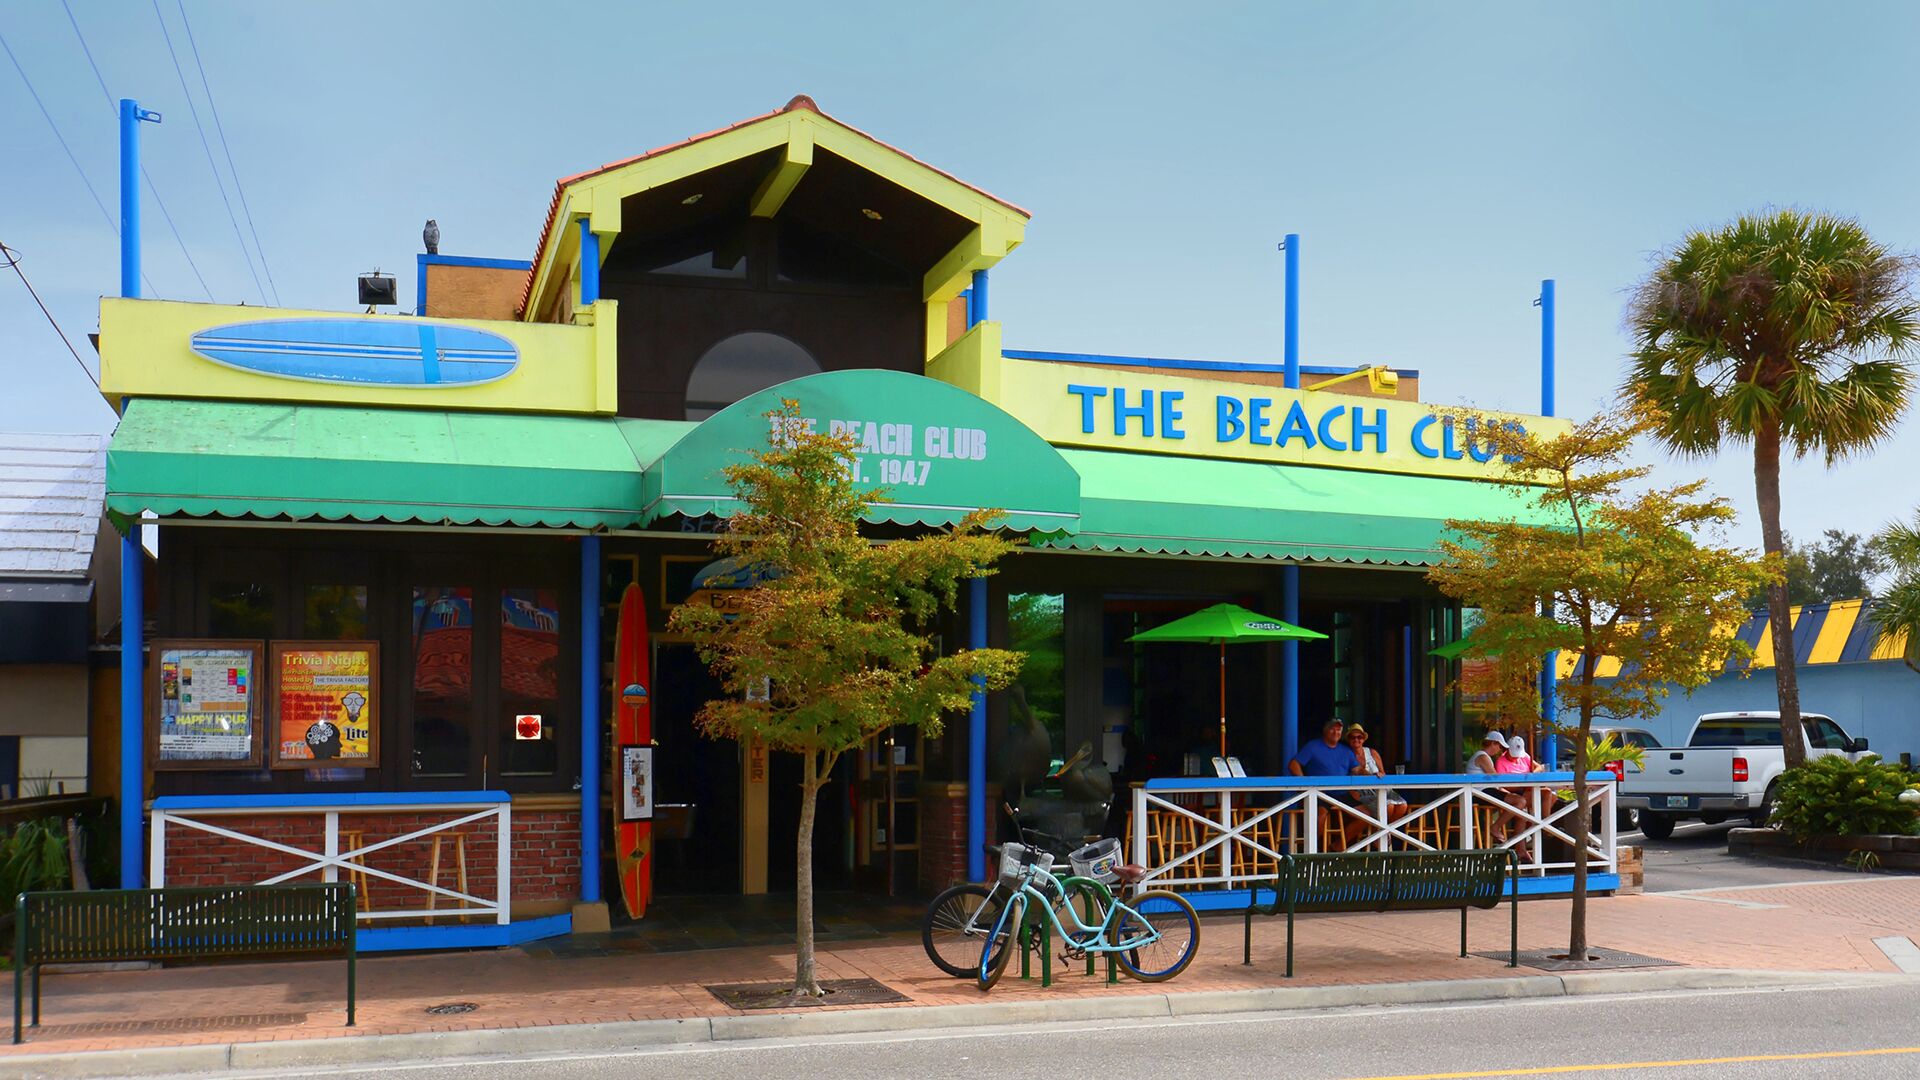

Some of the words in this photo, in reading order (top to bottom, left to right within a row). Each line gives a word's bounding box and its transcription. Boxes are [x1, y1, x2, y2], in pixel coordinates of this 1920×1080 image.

[1068, 384, 1185, 439] THE
[1216, 395, 1387, 453] BEACH
[924, 427, 987, 461] CLUB
[880, 458, 931, 486] 1947
[283, 653, 323, 665] Trivia
[327, 655, 367, 669] Night
[305, 676, 313, 685] by
[175, 715, 213, 725] HAPPY
[216, 714, 247, 724] HOUR
[344, 727, 369, 741] Lite
